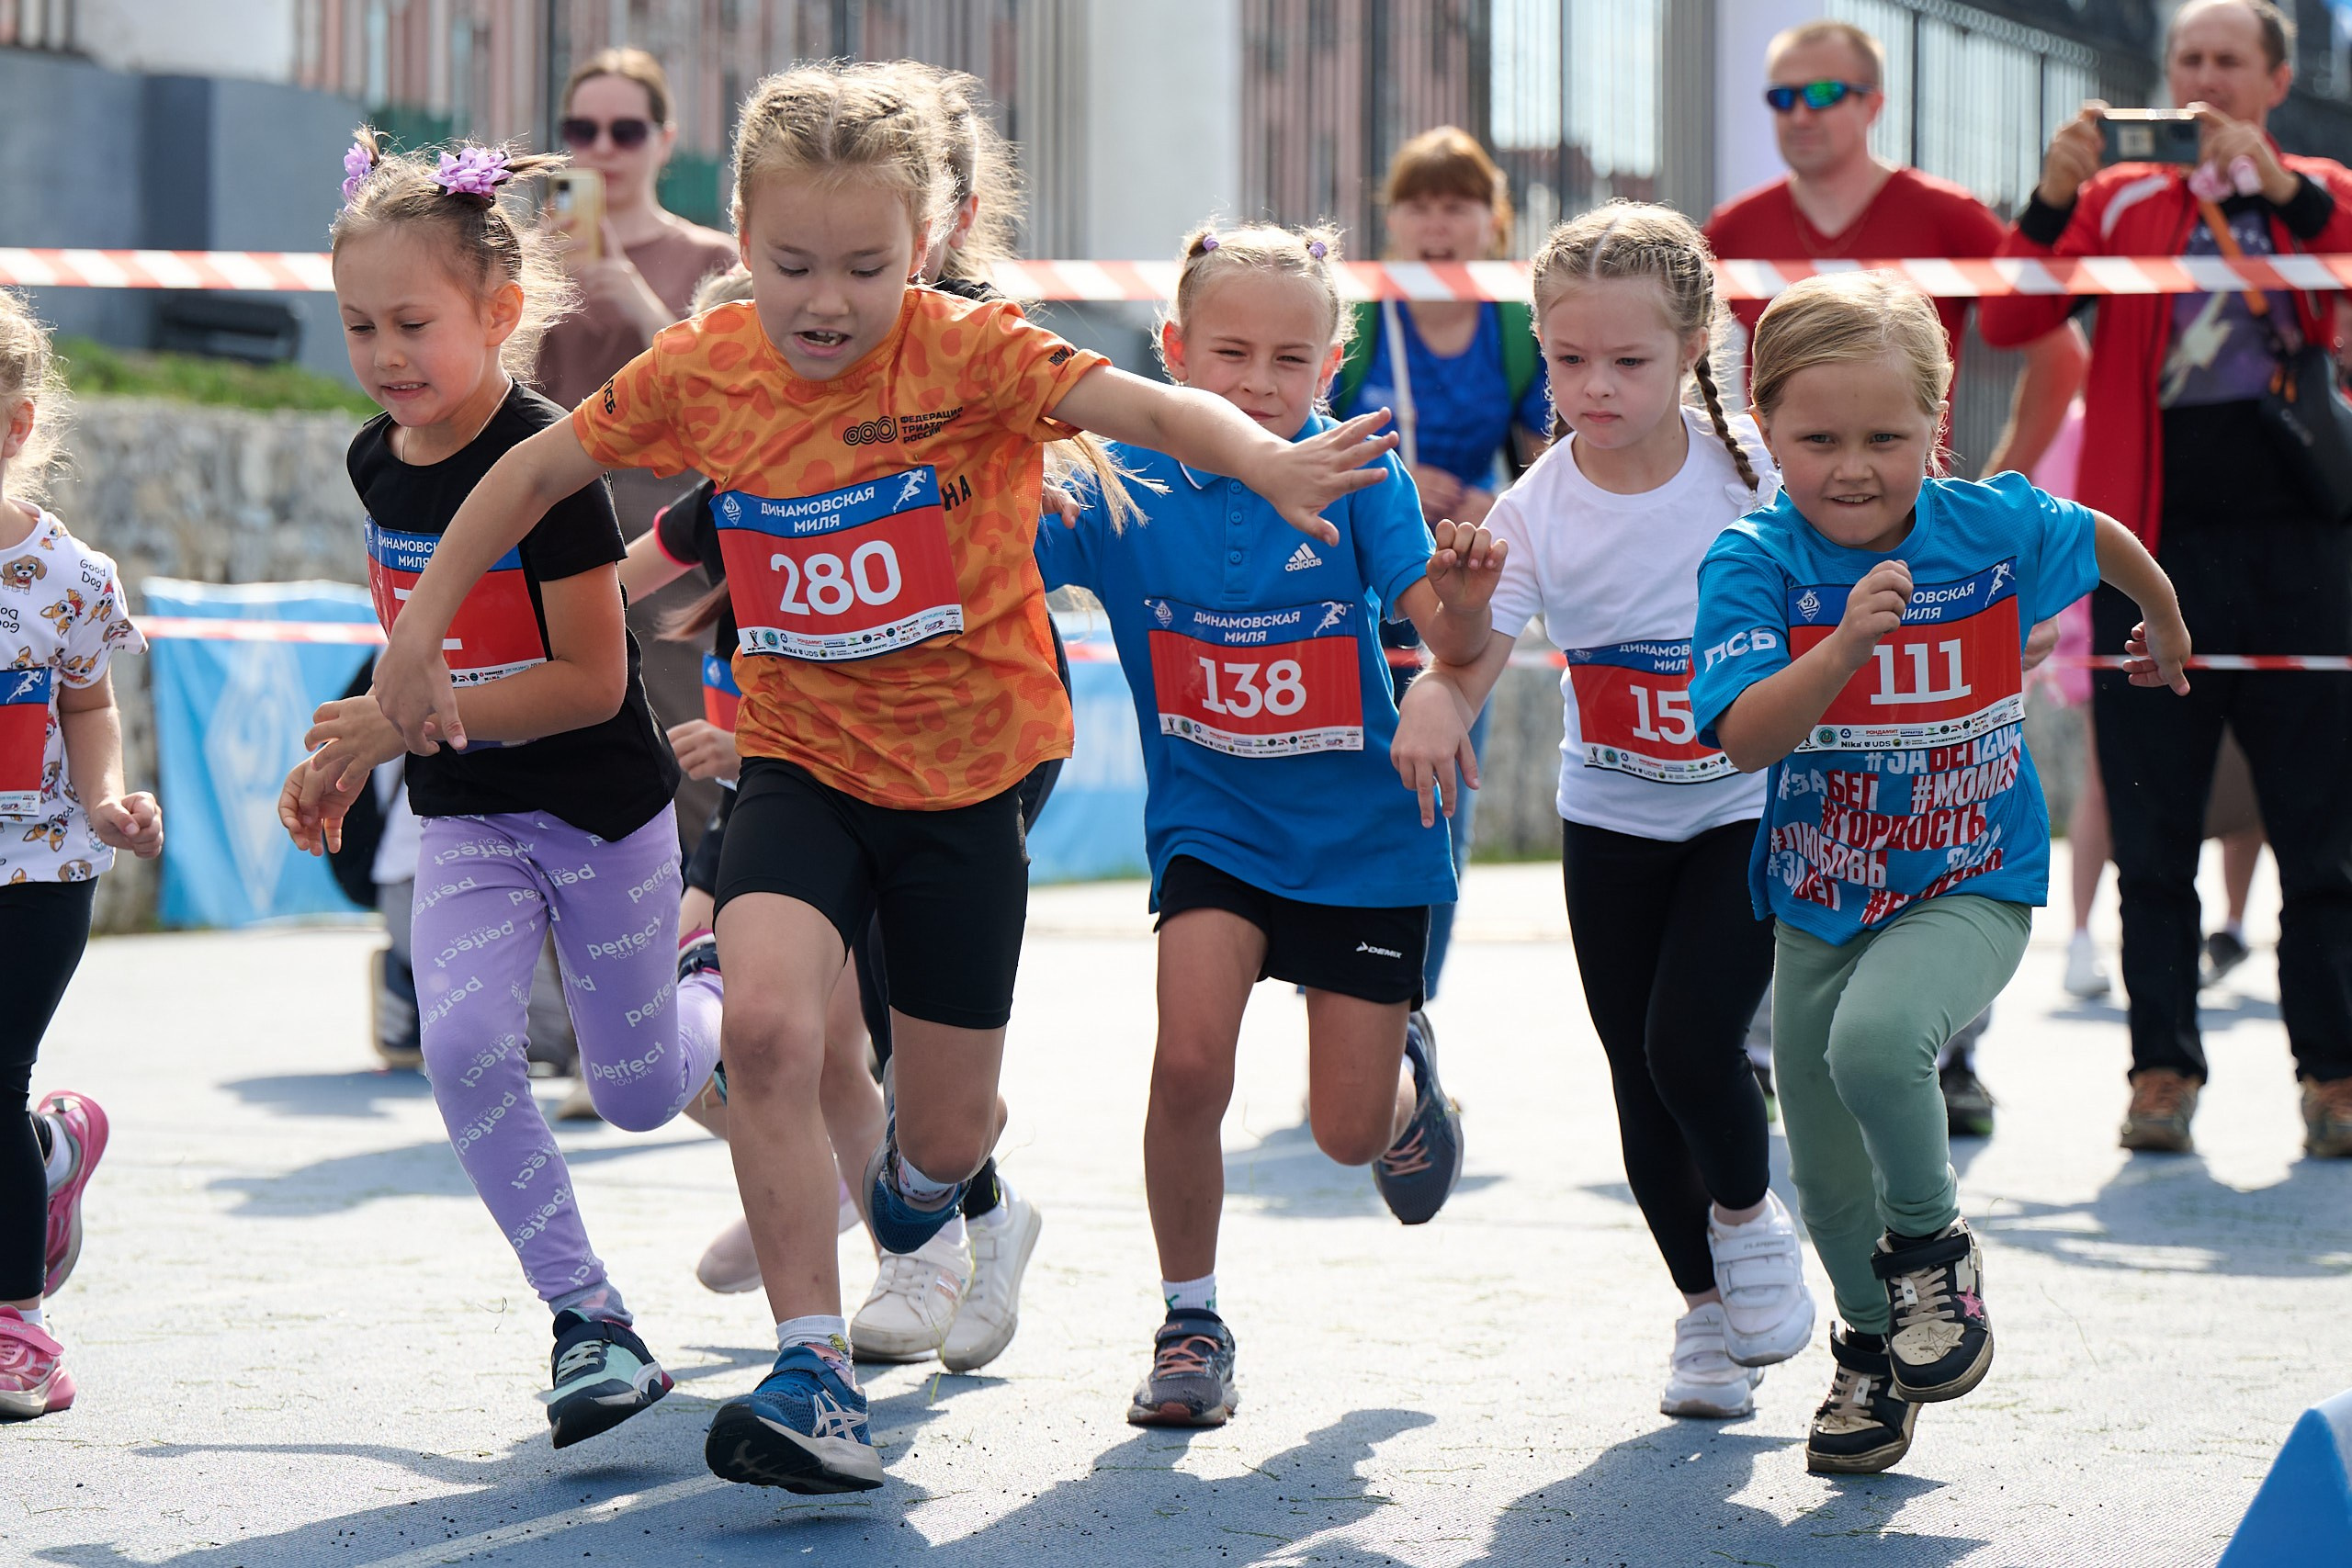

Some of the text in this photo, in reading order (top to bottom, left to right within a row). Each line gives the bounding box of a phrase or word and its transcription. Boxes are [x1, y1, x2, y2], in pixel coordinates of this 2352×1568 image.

[903, 426, 941, 444] РОССИИ
[761, 486, 875, 518] ДИНАМОВСКАЯ
[794, 513, 841, 533] МИЛЯ
[378, 534, 438, 554] ДИНАМОВС
[80, 558, 107, 577] Good
[1284, 557, 1323, 572] adidas
[81, 571, 102, 592] Dog
[770, 540, 902, 615] 280
[1909, 581, 1975, 606] ОВСКАЯ
[0, 606, 18, 620] Do
[1193, 611, 1301, 630] ДИНАМОВСКАЯ
[1224, 630, 1267, 643] МИЛЯ
[804, 649, 819, 658] UDS
[1619, 644, 1691, 657] ДИНАМОВ
[1703, 627, 1777, 674] ПСБ
[1870, 638, 1972, 705] 111
[1198, 656, 1307, 718] 138
[1629, 684, 1698, 745] 15
[1778, 763, 1879, 811] #ЗАБЕГ
[1819, 795, 1987, 852] #ГОРДОСТЬ
[1770, 821, 1888, 889] #ЛЮБОВЬ
[434, 920, 514, 968] perfect
[586, 917, 662, 961] perfect
[612, 950, 634, 960] YOU
[1367, 945, 1403, 959] DEMIX
[420, 976, 484, 1034] perfec
[625, 973, 677, 1028] perfec
[591, 1041, 665, 1081] perfect
[611, 1066, 653, 1087] YOU ARE
